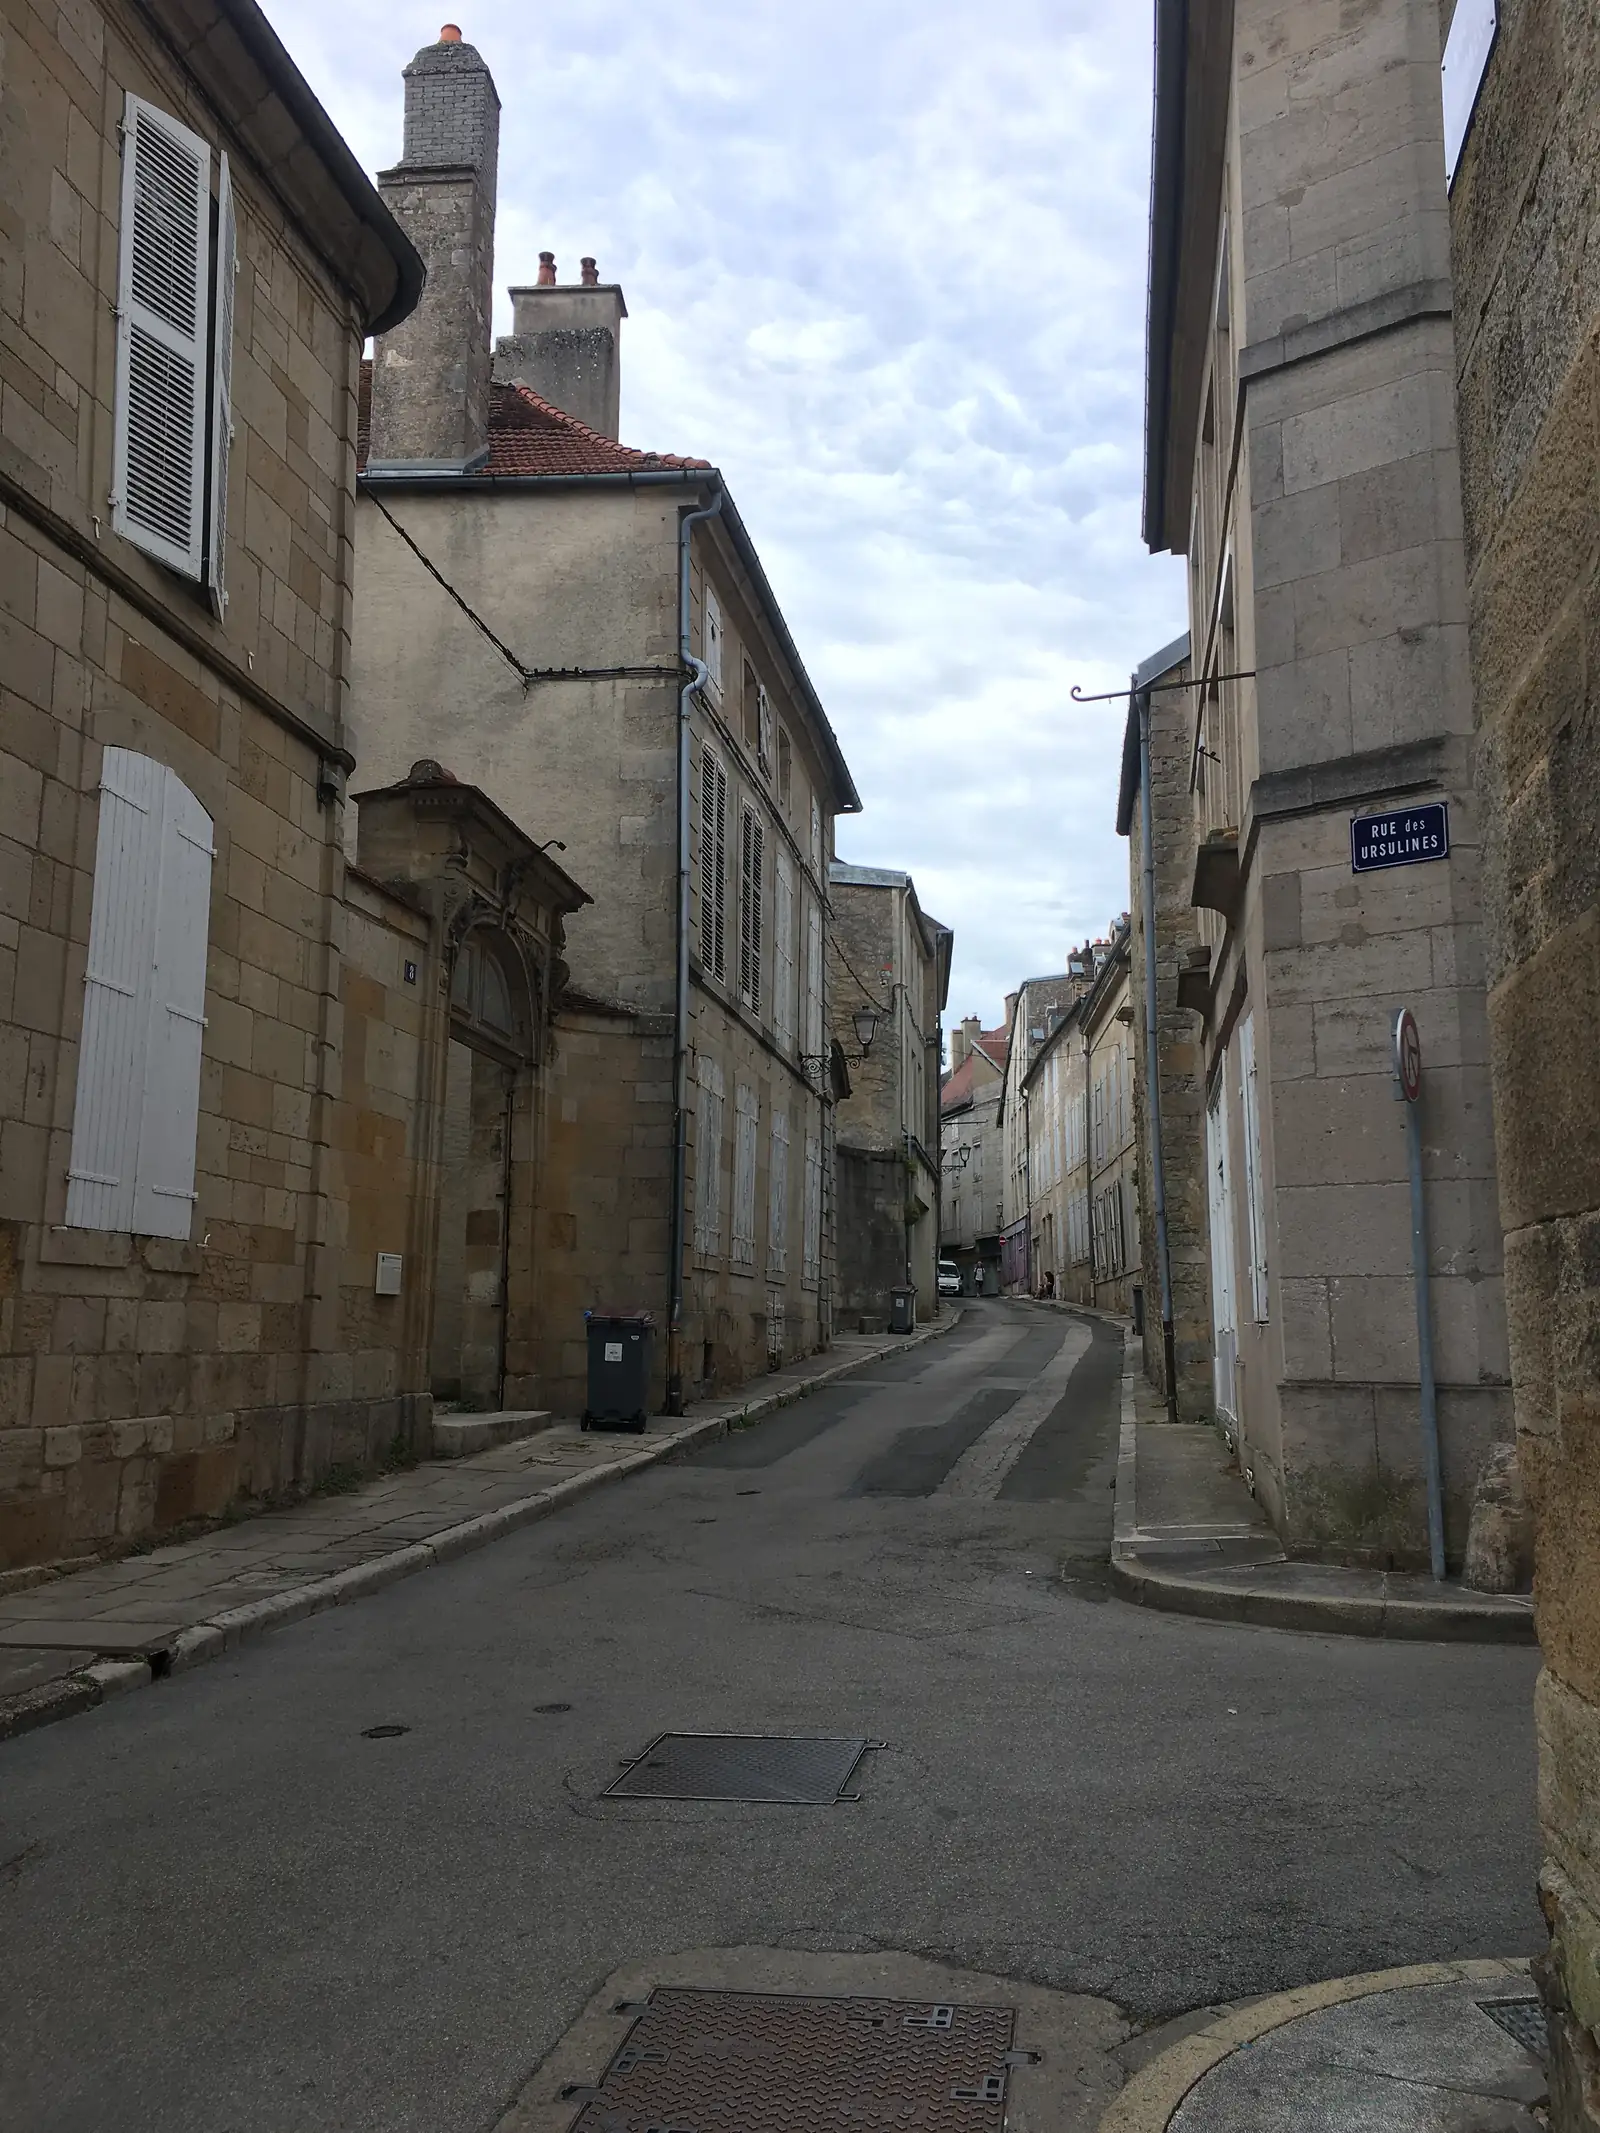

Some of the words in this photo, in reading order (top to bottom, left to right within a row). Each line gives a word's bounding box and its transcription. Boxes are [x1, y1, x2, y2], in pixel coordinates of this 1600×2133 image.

[1372, 822, 1396, 838] RUE
[1405, 819, 1425, 832] des
[1361, 835, 1438, 859] URSULINES
